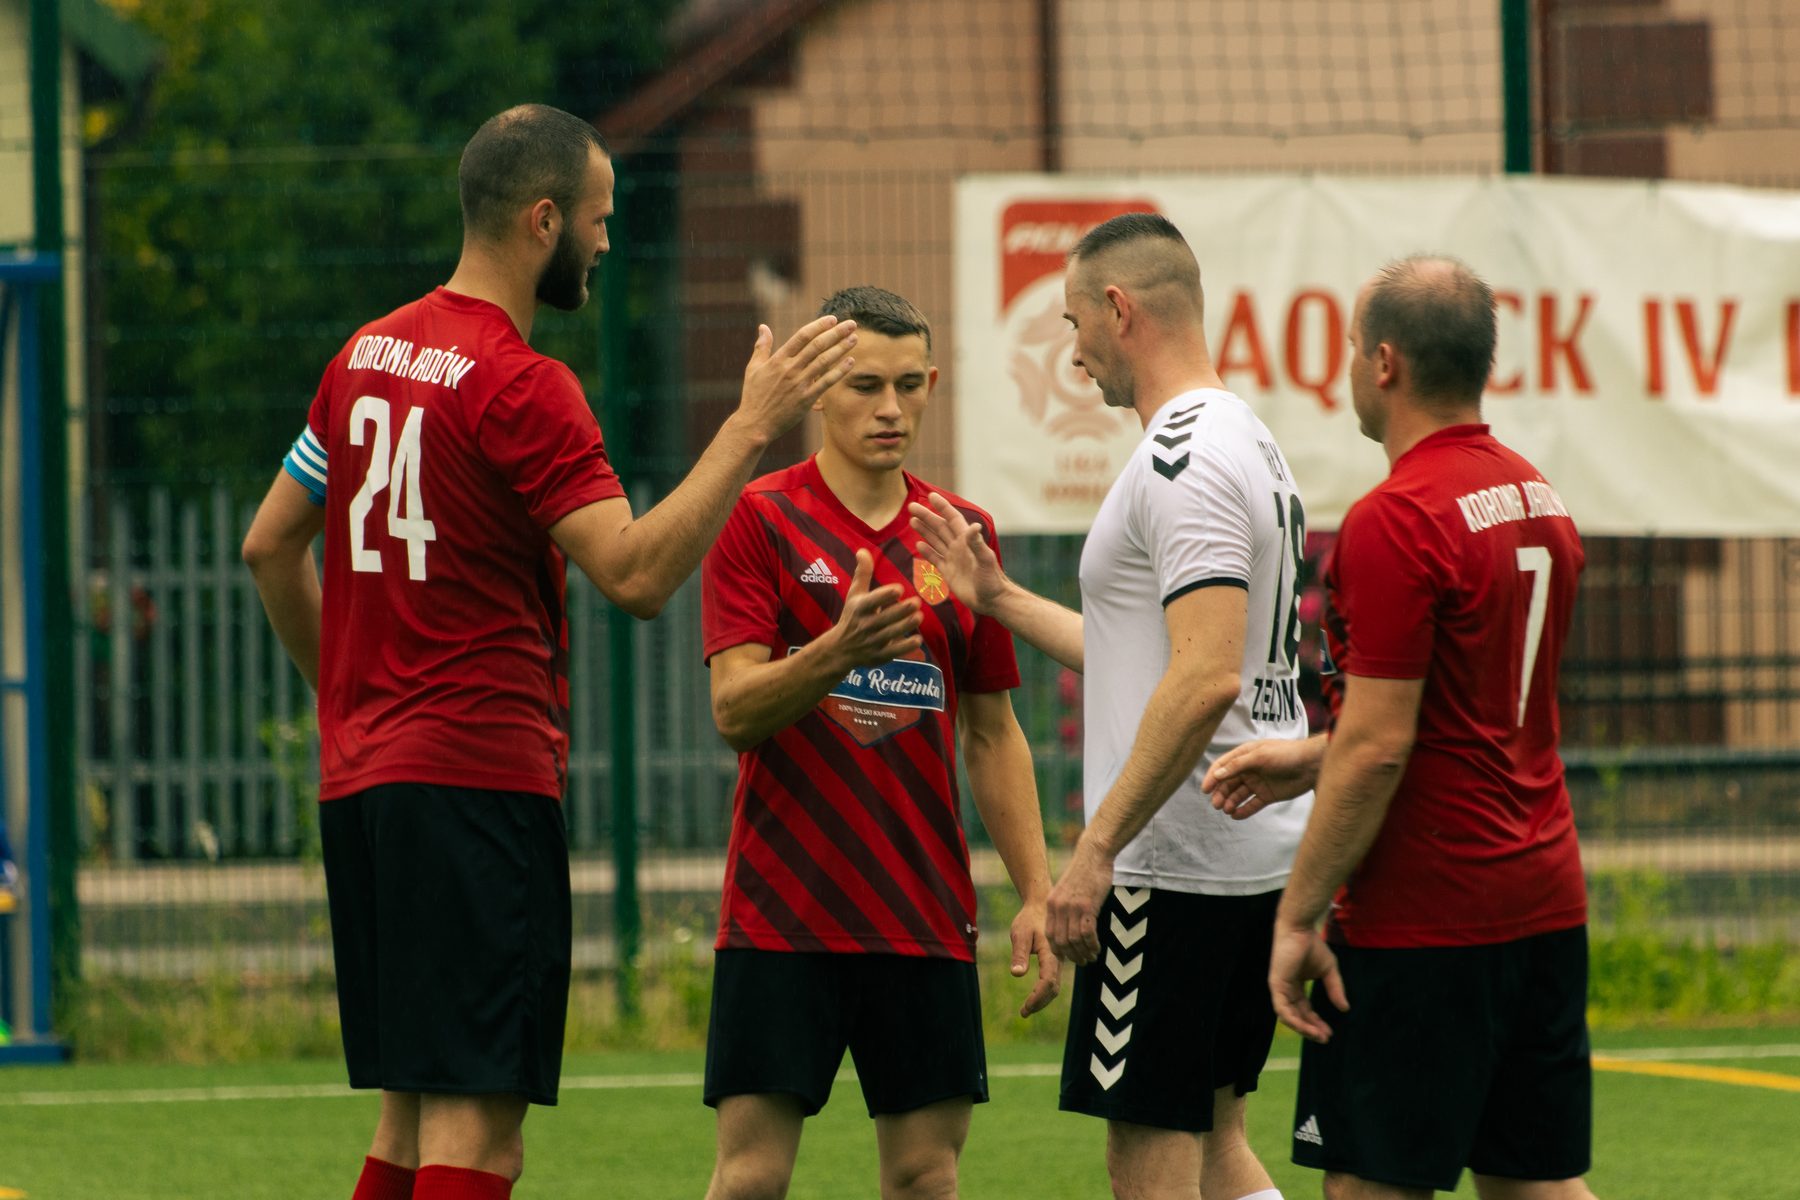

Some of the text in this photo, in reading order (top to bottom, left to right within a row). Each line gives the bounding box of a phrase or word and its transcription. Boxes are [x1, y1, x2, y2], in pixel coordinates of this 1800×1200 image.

[347, 334, 414, 379] KORONA
[1645, 297, 1738, 397] IV
[349, 395, 437, 581] 24
[1456, 483, 1527, 533] KORONA
[800, 573, 839, 585] adidas
[1515, 546, 1553, 728] 7
[867, 667, 941, 700] Rodzinka
